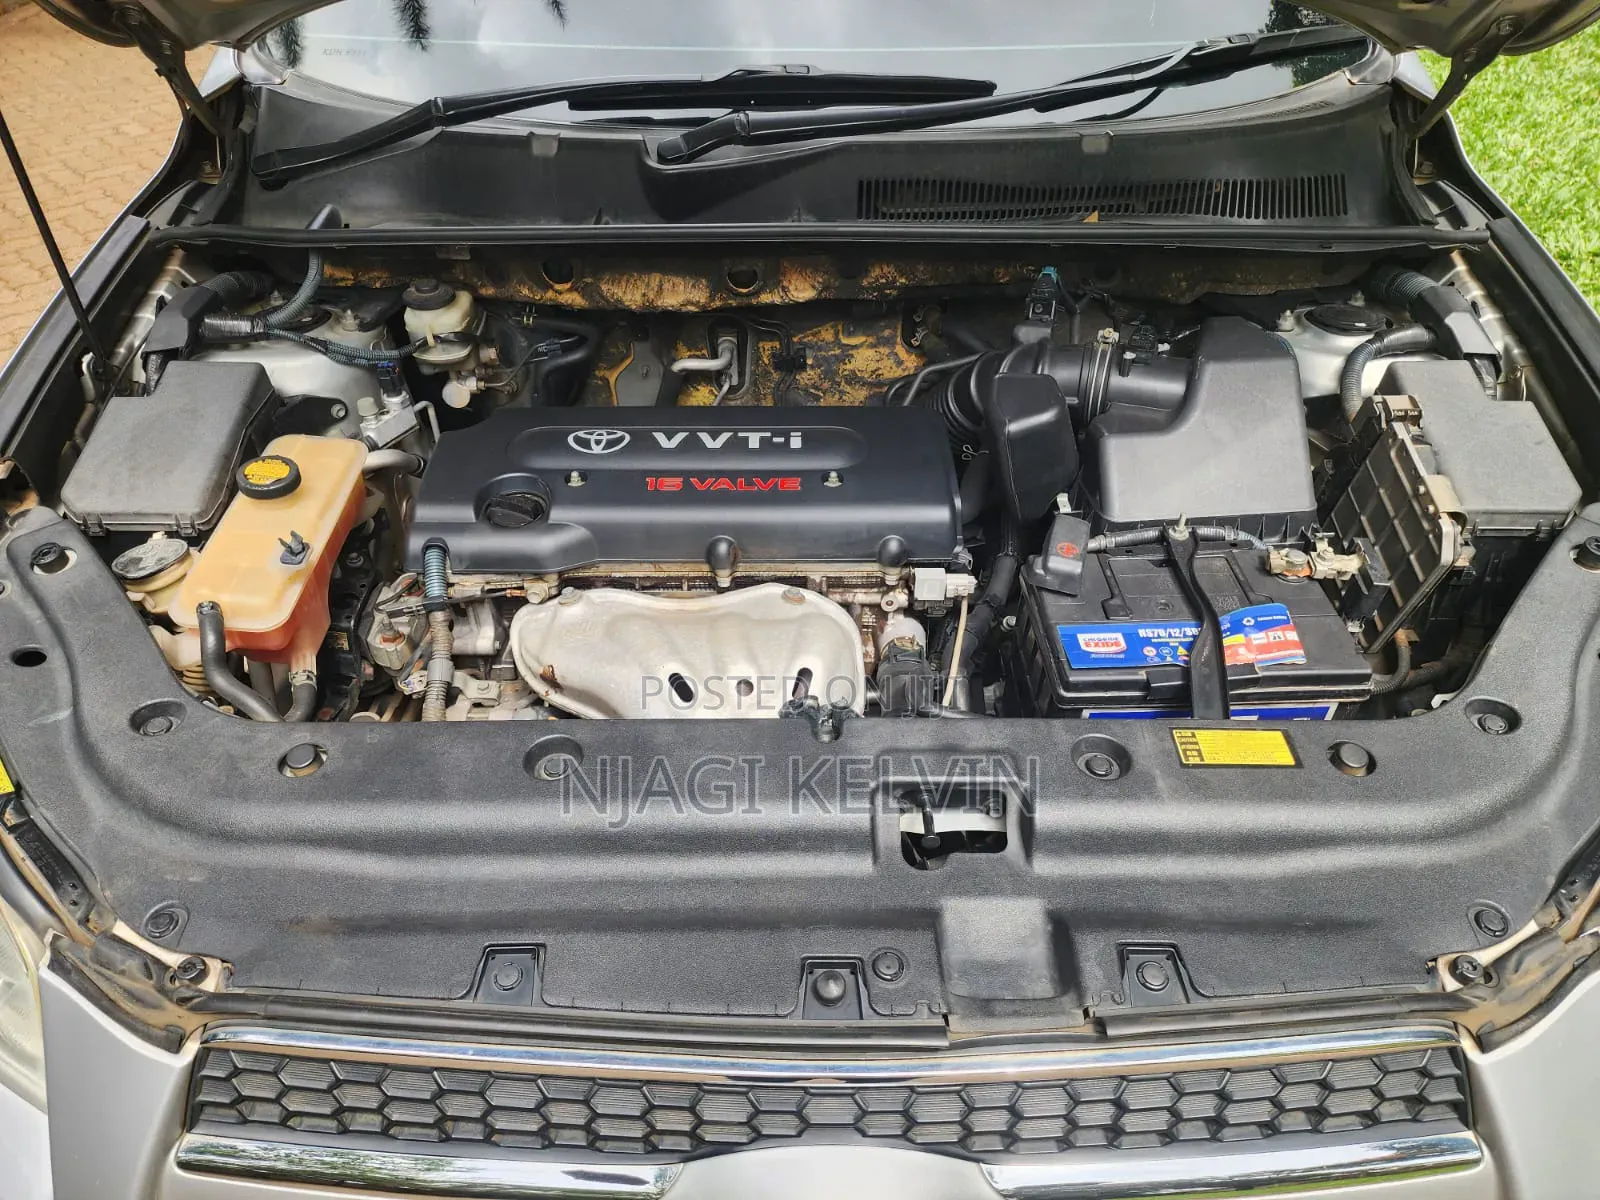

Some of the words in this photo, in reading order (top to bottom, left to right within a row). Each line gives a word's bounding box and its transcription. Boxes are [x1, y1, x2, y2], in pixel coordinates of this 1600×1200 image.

[652, 431, 801, 449] VVT-i
[646, 477, 684, 491] 16
[690, 477, 801, 491] VALVE
